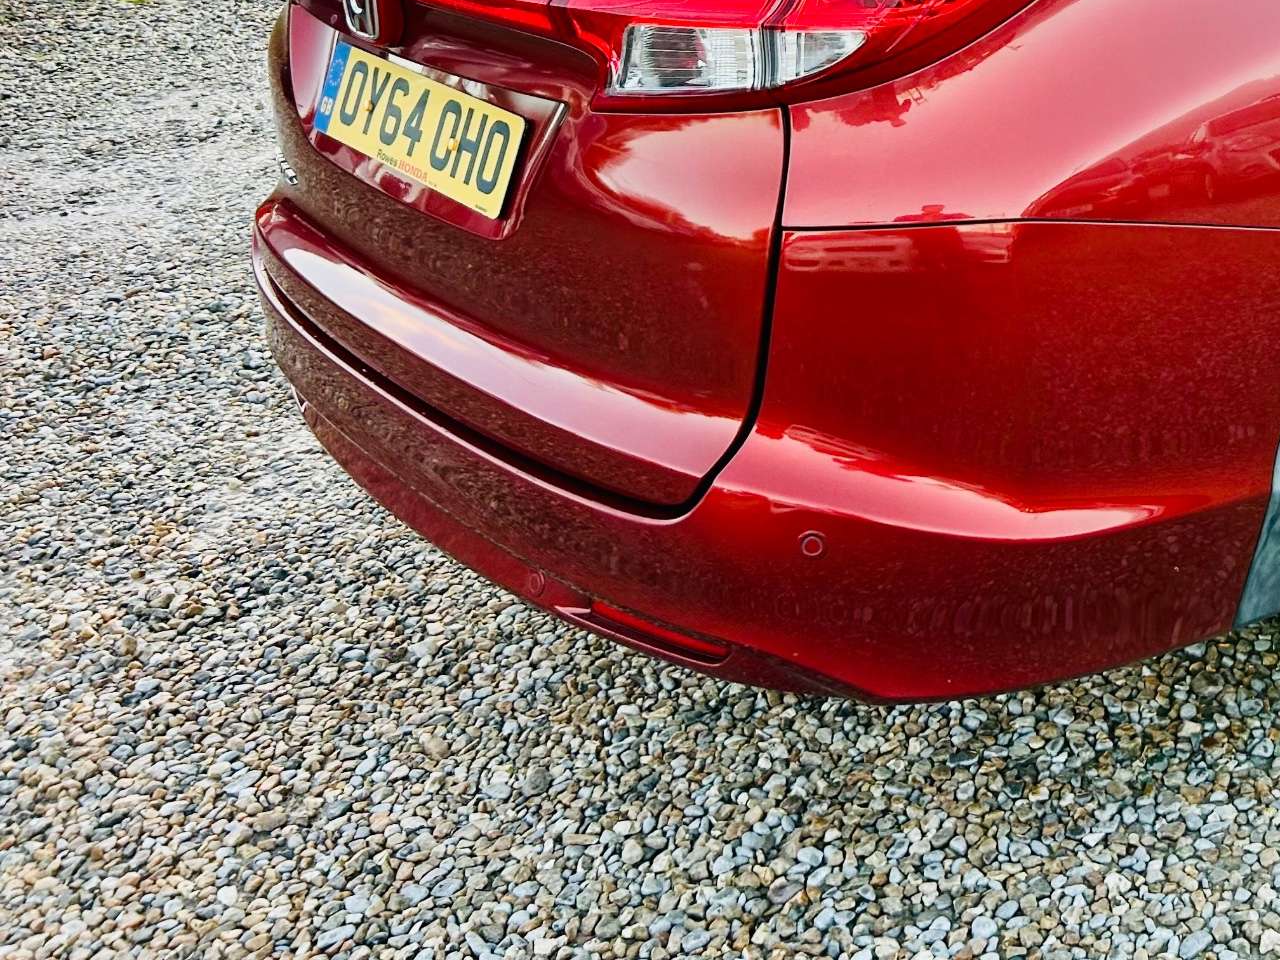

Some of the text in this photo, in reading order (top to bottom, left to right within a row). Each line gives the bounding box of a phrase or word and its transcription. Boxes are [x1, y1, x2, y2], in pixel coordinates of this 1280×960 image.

[320, 95, 334, 116] GB
[338, 60, 511, 195] OY64 CHO
[398, 159, 429, 182] HONDA
